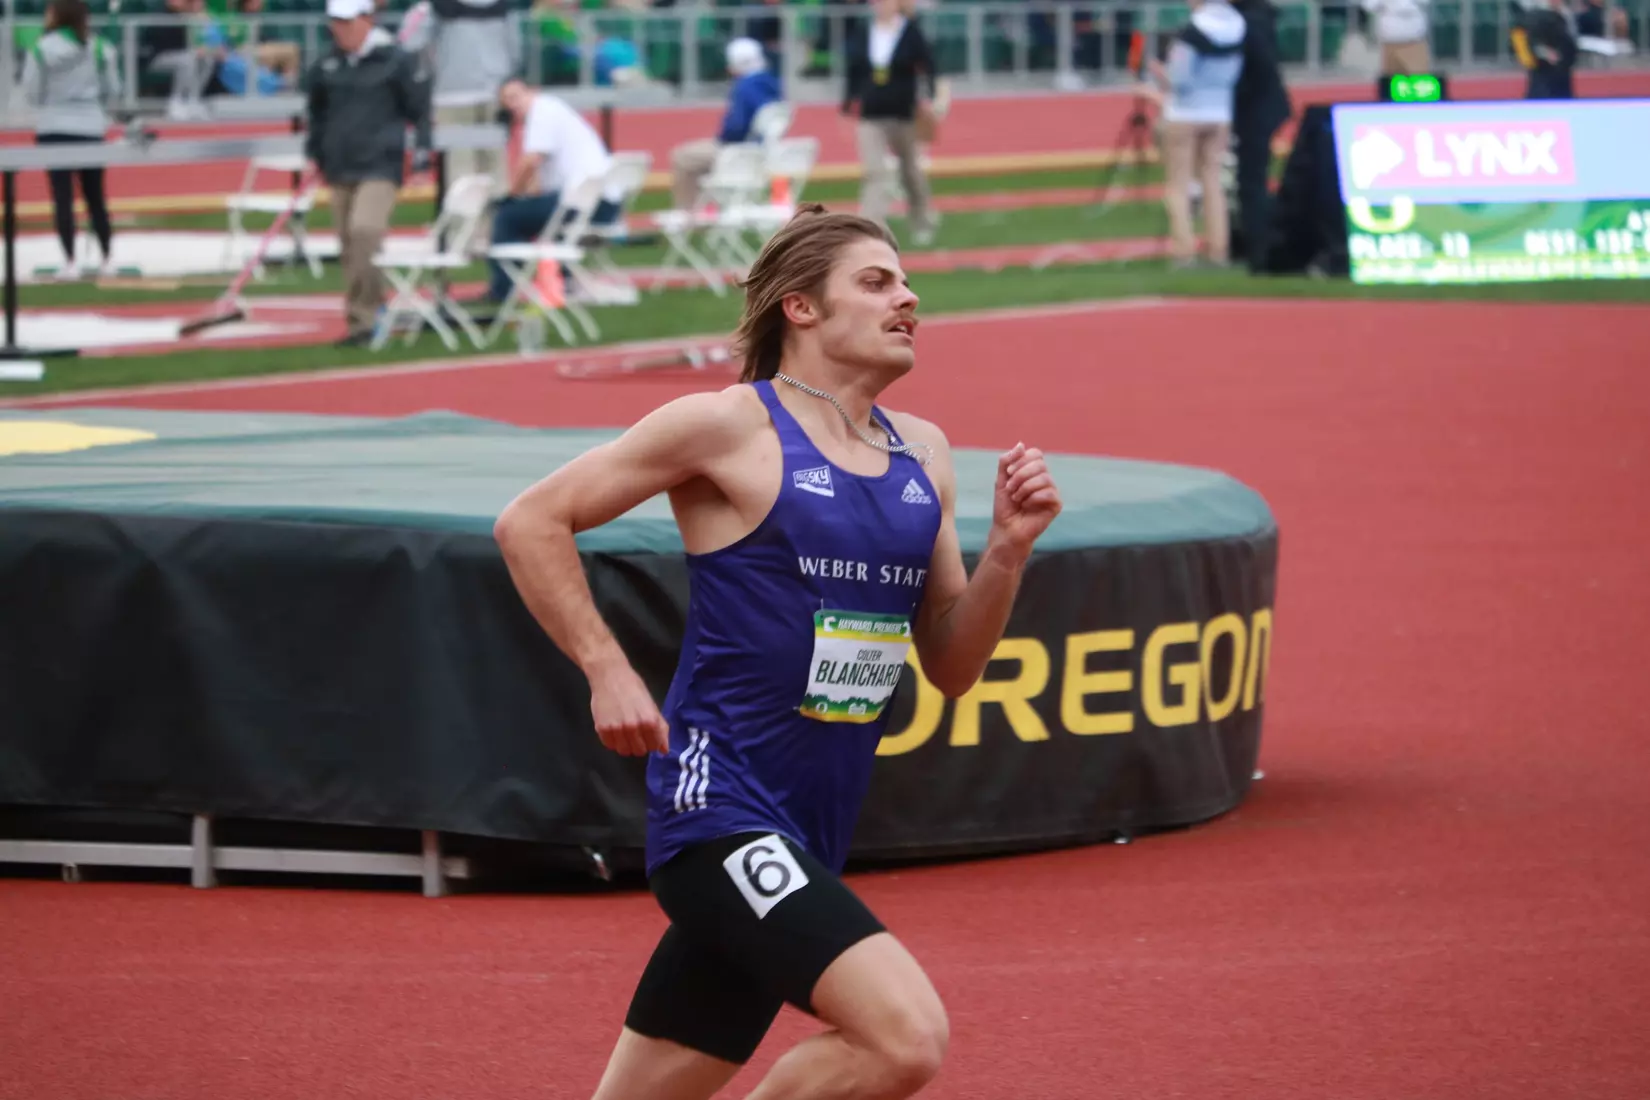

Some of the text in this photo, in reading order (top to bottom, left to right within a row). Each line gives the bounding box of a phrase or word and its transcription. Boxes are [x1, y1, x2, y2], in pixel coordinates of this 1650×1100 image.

[1414, 130, 1558, 177] LYNX
[901, 491, 932, 505] adidas
[798, 556, 868, 582] WEBER
[838, 618, 872, 632] HAYWARD
[856, 649, 884, 662] COLTER
[814, 660, 903, 688] BLANCHARD
[742, 845, 791, 898] 6
